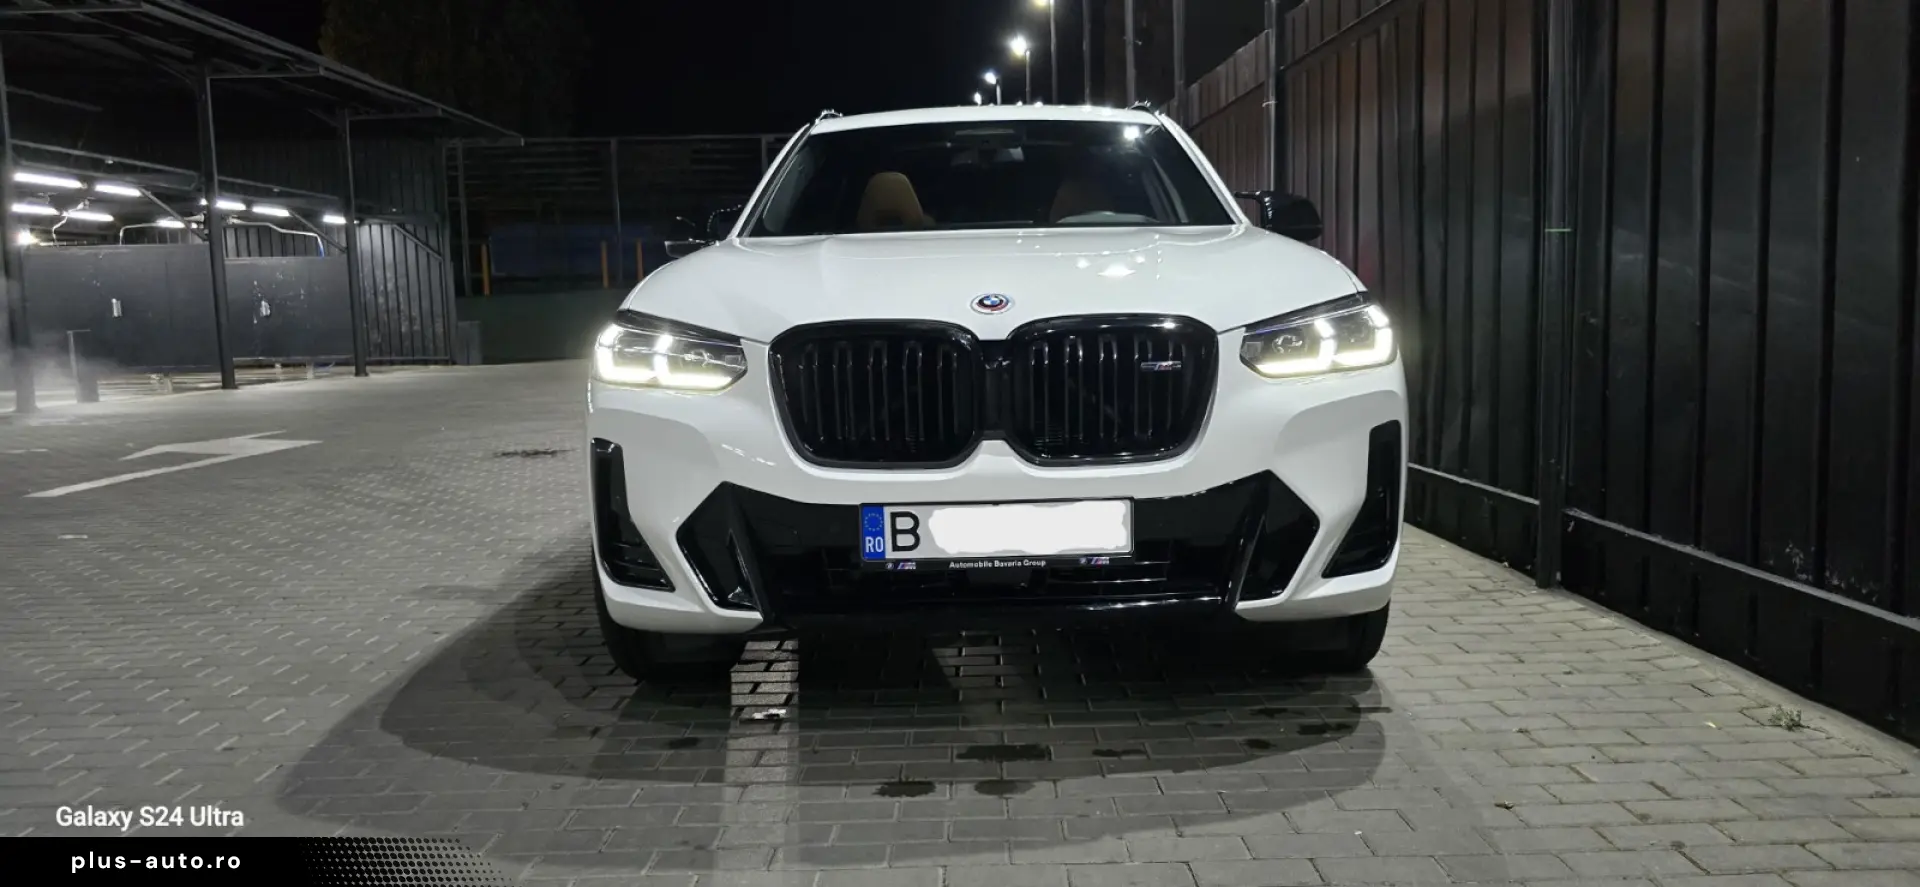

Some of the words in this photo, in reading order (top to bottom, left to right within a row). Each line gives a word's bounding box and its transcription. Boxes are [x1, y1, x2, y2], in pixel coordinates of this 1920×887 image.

[890, 511, 920, 552] B
[865, 536, 884, 553] RO
[1023, 559, 1046, 567] Group
